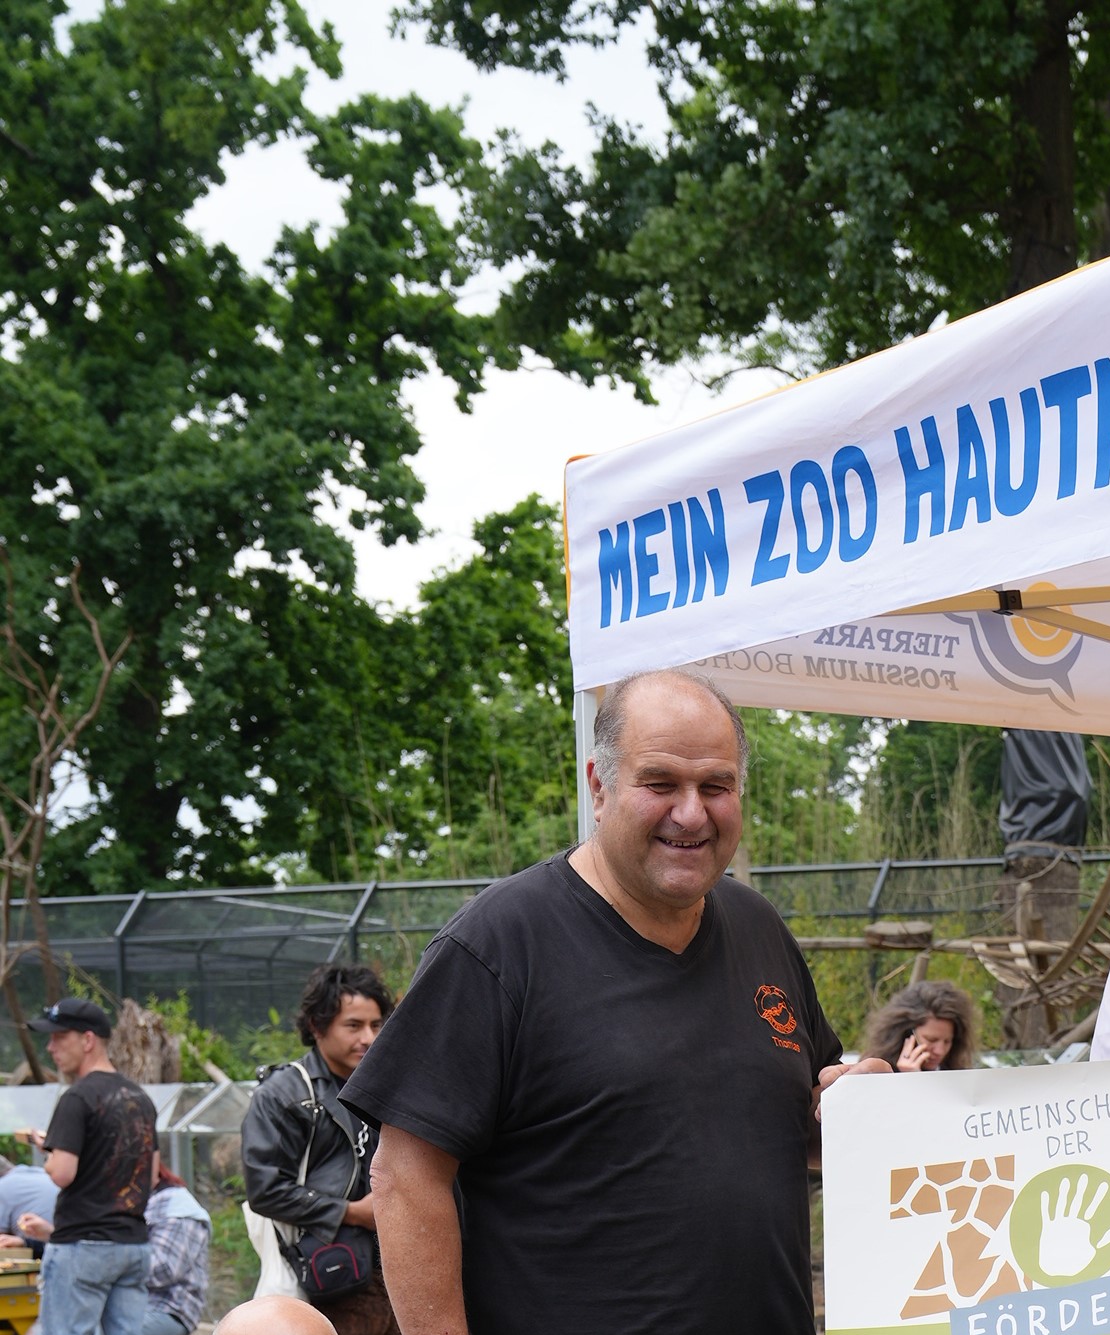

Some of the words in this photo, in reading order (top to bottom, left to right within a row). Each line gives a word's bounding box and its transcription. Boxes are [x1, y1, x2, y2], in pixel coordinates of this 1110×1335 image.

[598, 487, 729, 629] MEIN
[743, 445, 878, 587] ZOO
[1046, 1130, 1092, 1159] DER
